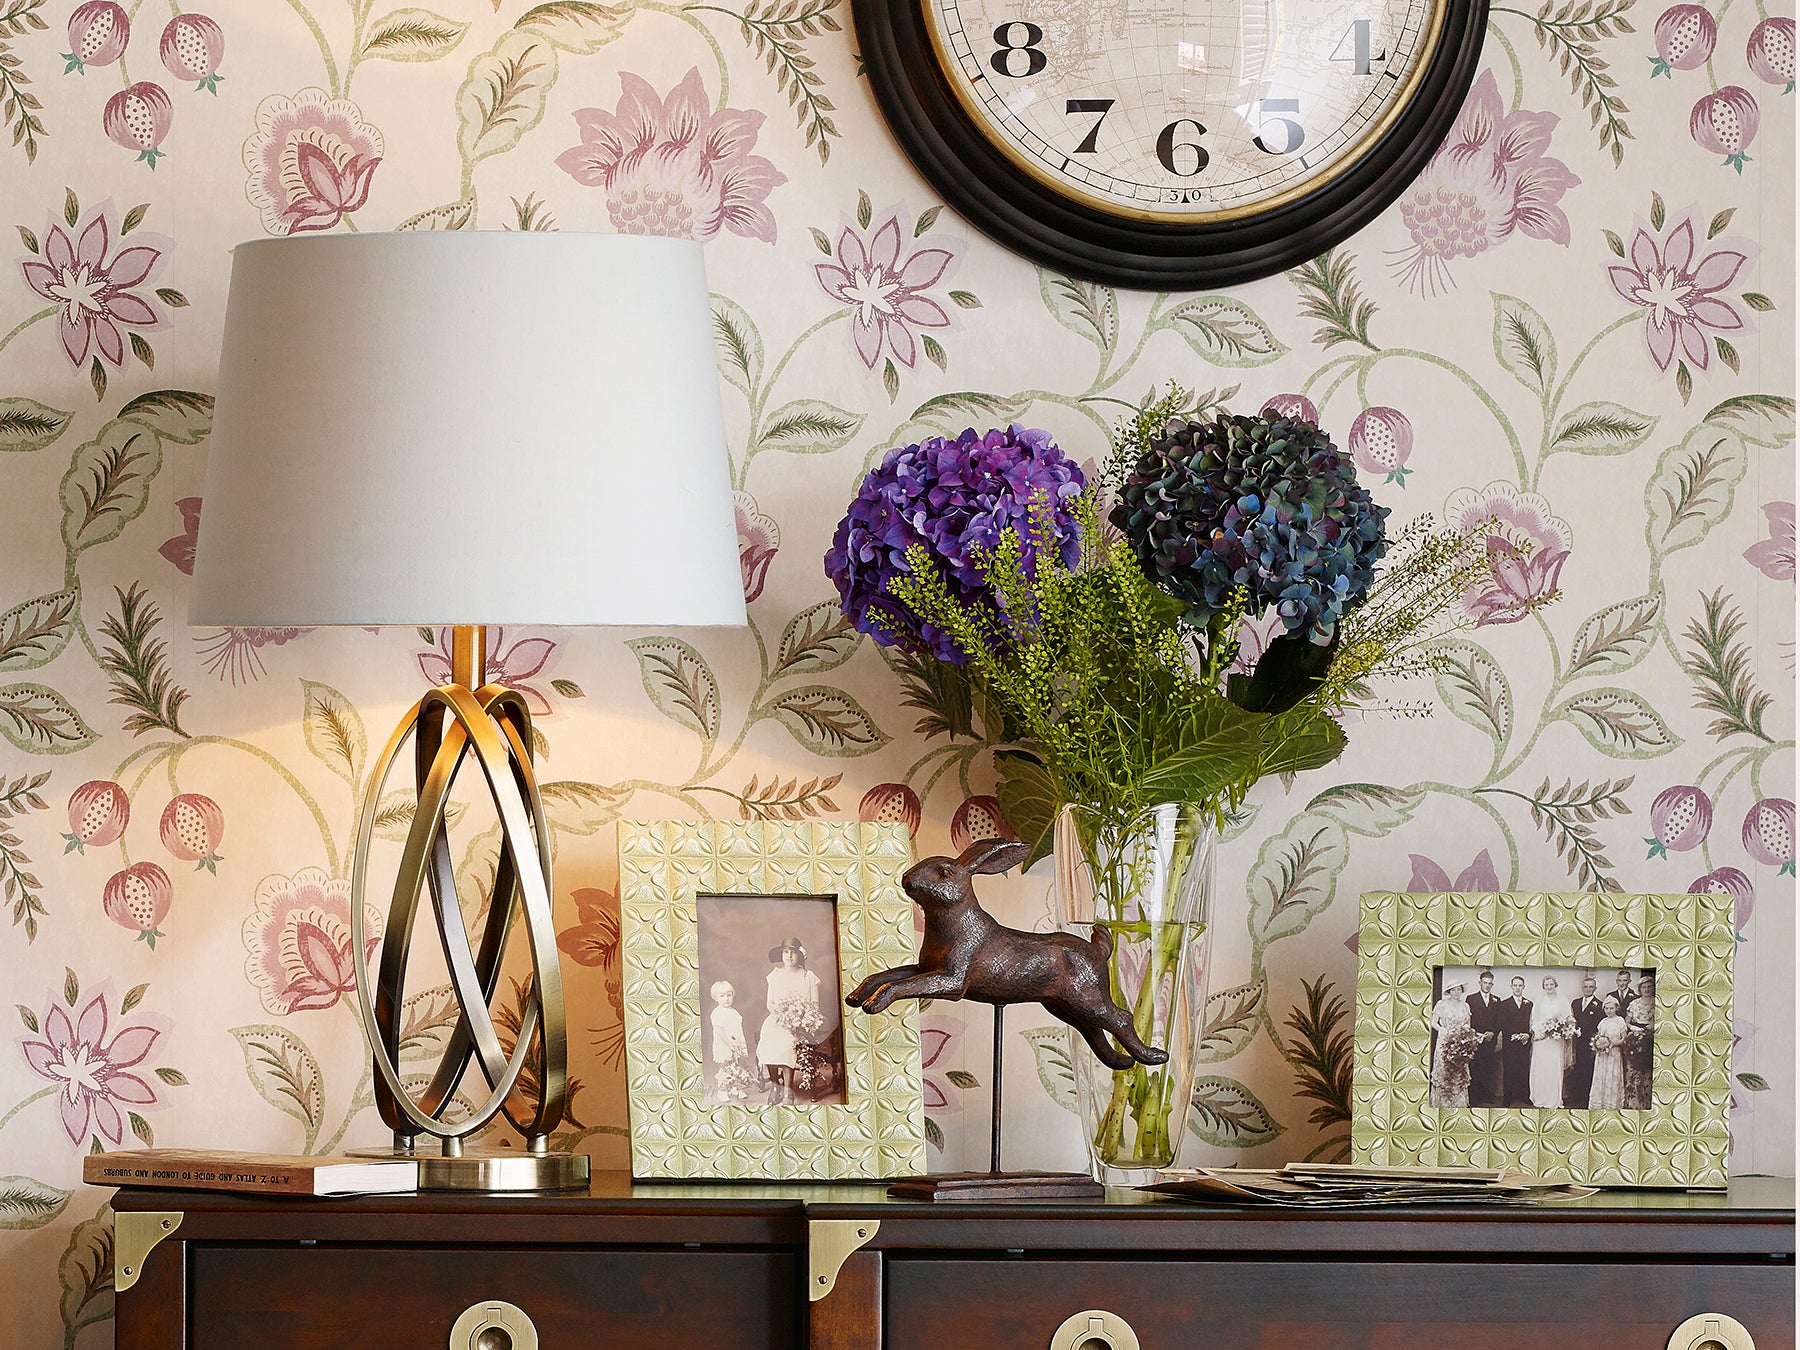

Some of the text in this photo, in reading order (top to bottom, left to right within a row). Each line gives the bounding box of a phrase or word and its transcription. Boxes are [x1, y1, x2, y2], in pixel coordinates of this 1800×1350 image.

[990, 21, 1047, 78] 8
[1329, 19, 1386, 76] 4
[1066, 99, 1116, 154] 7
[1156, 118, 1210, 177] 6
[1252, 98, 1305, 155] 5
[103, 1168, 290, 1184] A TO Z ATLAS AND GUIDE TO LONDON AND SUBURBS
